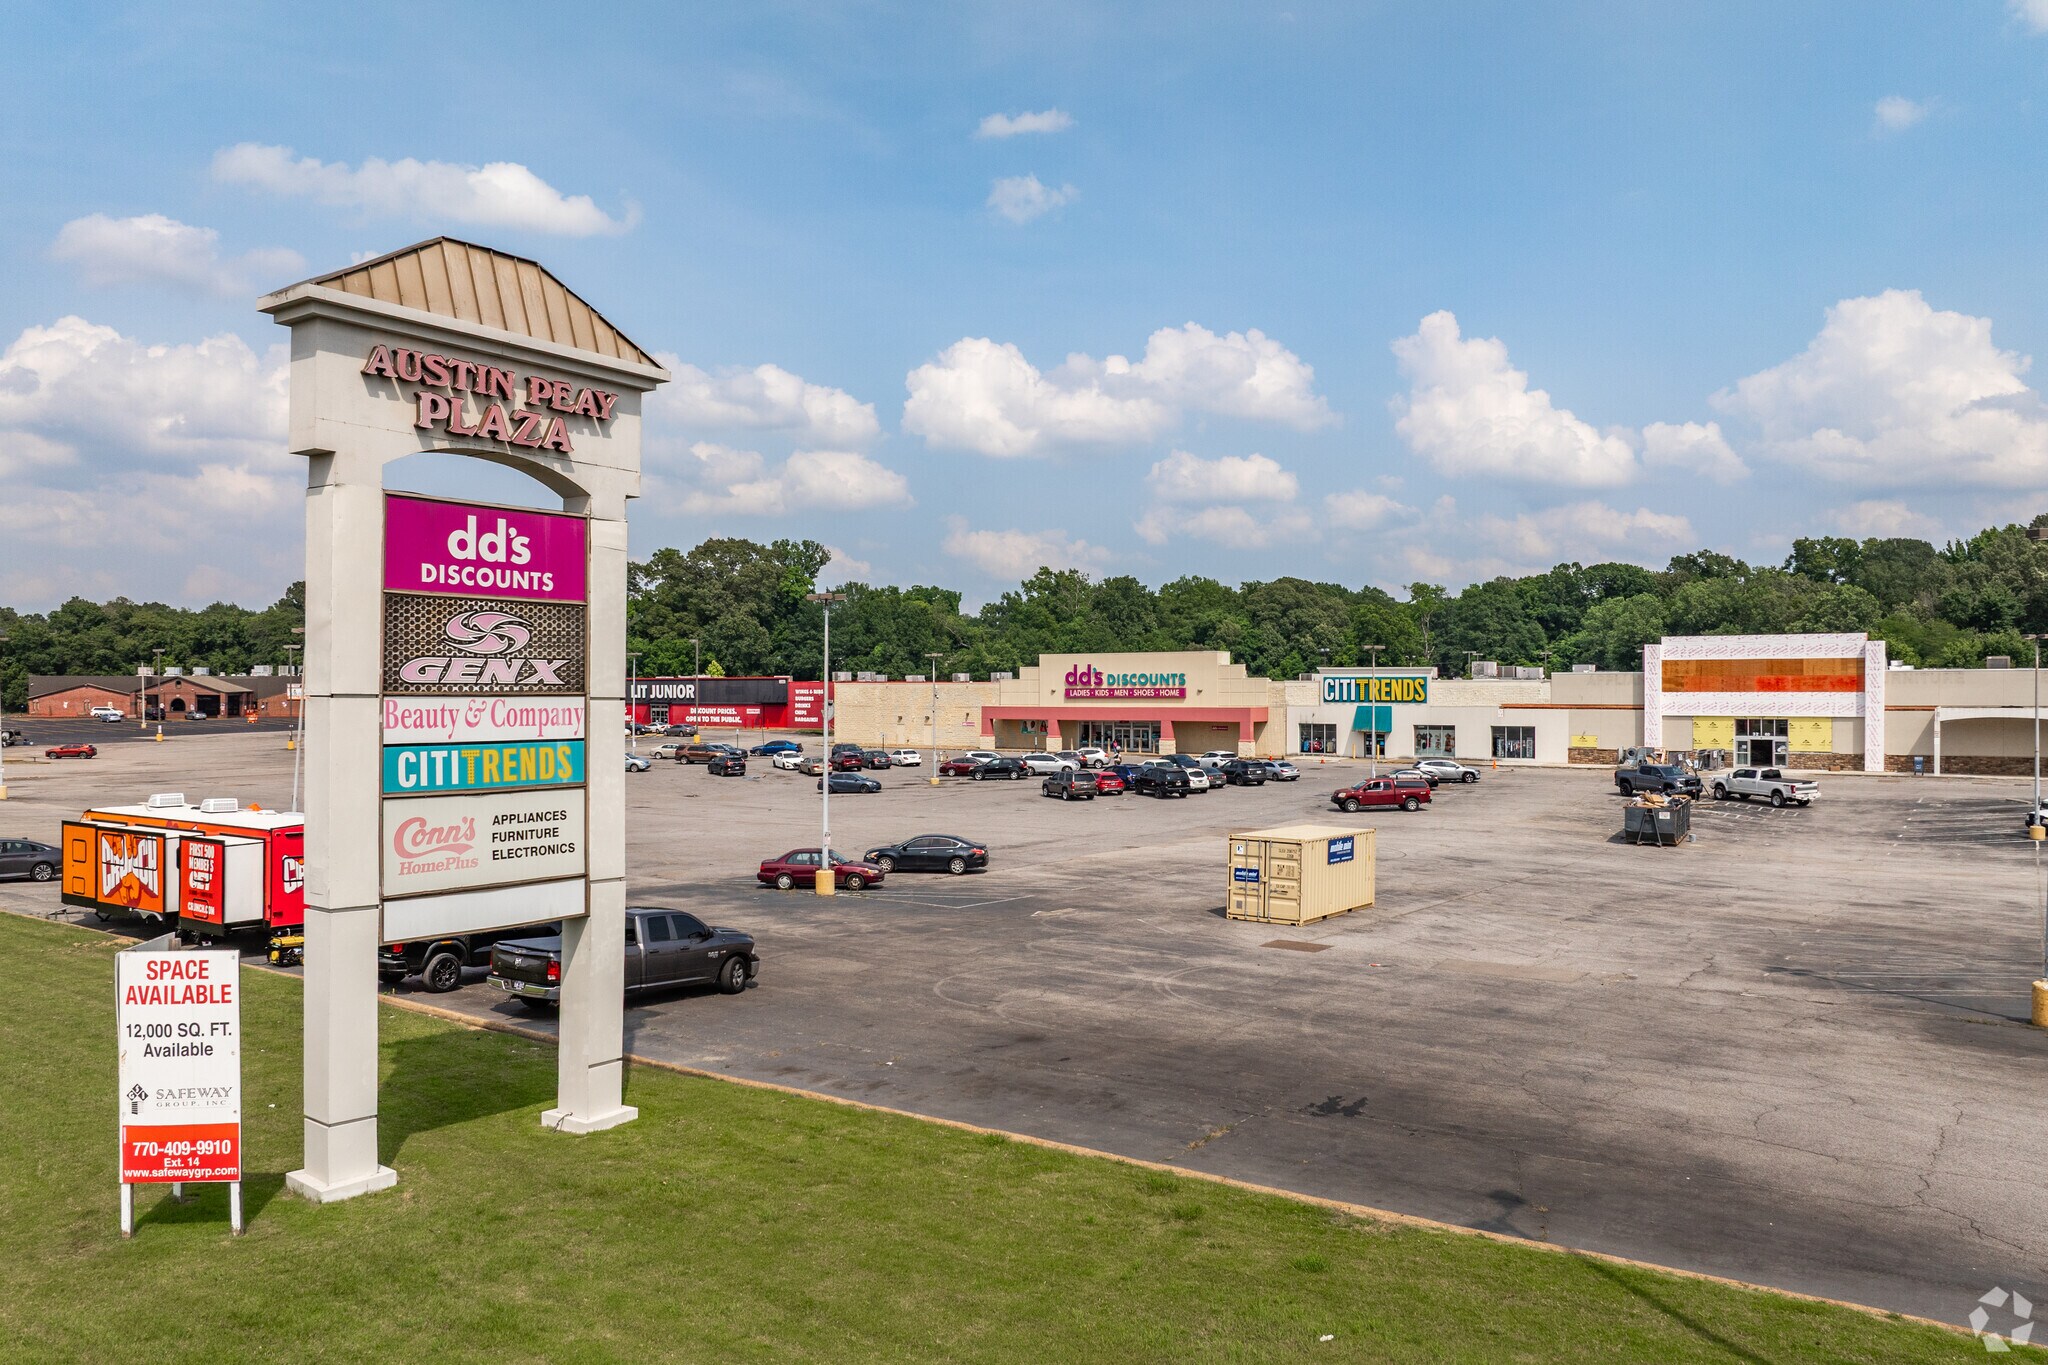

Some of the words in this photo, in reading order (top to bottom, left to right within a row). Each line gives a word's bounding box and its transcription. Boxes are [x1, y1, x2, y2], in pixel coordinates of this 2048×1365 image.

[361, 344, 516, 400] AUSTIN
[524, 375, 619, 420] PEAY
[414, 390, 574, 452] PLAZA
[447, 515, 531, 565] dd's
[421, 562, 554, 592] DISCOUNTS
[1065, 664, 1104, 686] dd's
[1107, 673, 1186, 686] DISCOUNTS
[649, 684, 695, 699] JUNIOR
[1069, 689, 1091, 697] LADIES
[1094, 689, 1109, 697] KIDS
[1113, 689, 1129, 697] MEN
[1133, 689, 1155, 697] SHOES
[1159, 689, 1180, 697] HOME
[384, 699, 460, 740] Beauty
[464, 698, 488, 729] &
[490, 698, 584, 738] Company
[492, 810, 568, 827] APPLIANCES
[393, 816, 476, 859] Conn's
[491, 827, 560, 843] FURNITURE
[492, 842, 576, 861] ELECTRONICS
[397, 857, 480, 877] HomePlus
[146, 959, 210, 981] SPACE
[125, 983, 232, 1005] AVAILABLE
[126, 1023, 173, 1040] 12,000
[177, 1022, 205, 1038] SQ.
[210, 1021, 232, 1037] FT.
[143, 1041, 214, 1058] Available
[156, 1086, 233, 1100] SAFEWAY
[132, 1139, 232, 1157] 770-409-9910
[163, 1158, 185, 1168] Ext.
[187, 1157, 200, 1167] 14
[124, 1166, 237, 1179] www.safewaygrp.com
